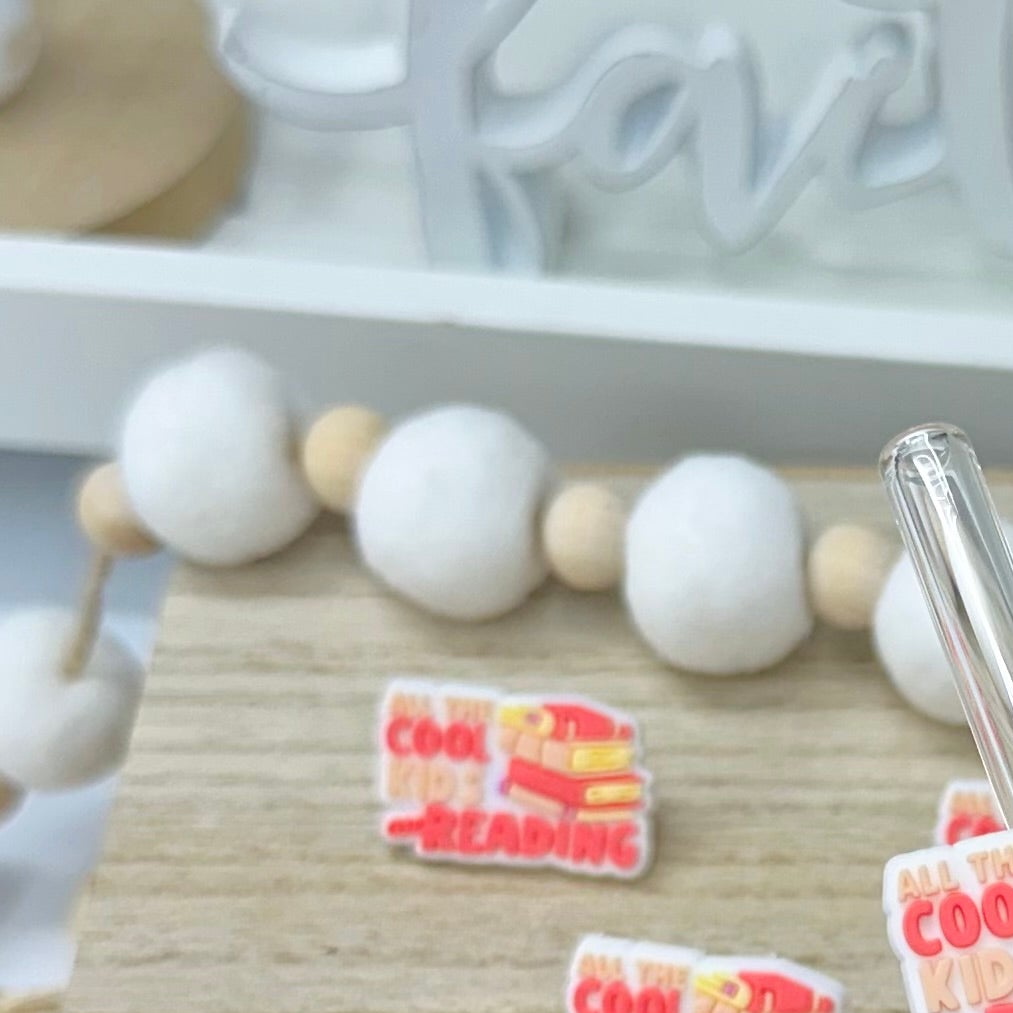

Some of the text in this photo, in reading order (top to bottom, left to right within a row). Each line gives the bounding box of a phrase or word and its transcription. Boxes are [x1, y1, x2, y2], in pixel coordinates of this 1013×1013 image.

[386, 717, 489, 764] COOL
[420, 803, 638, 869] READING
[898, 860, 958, 901] ALL
